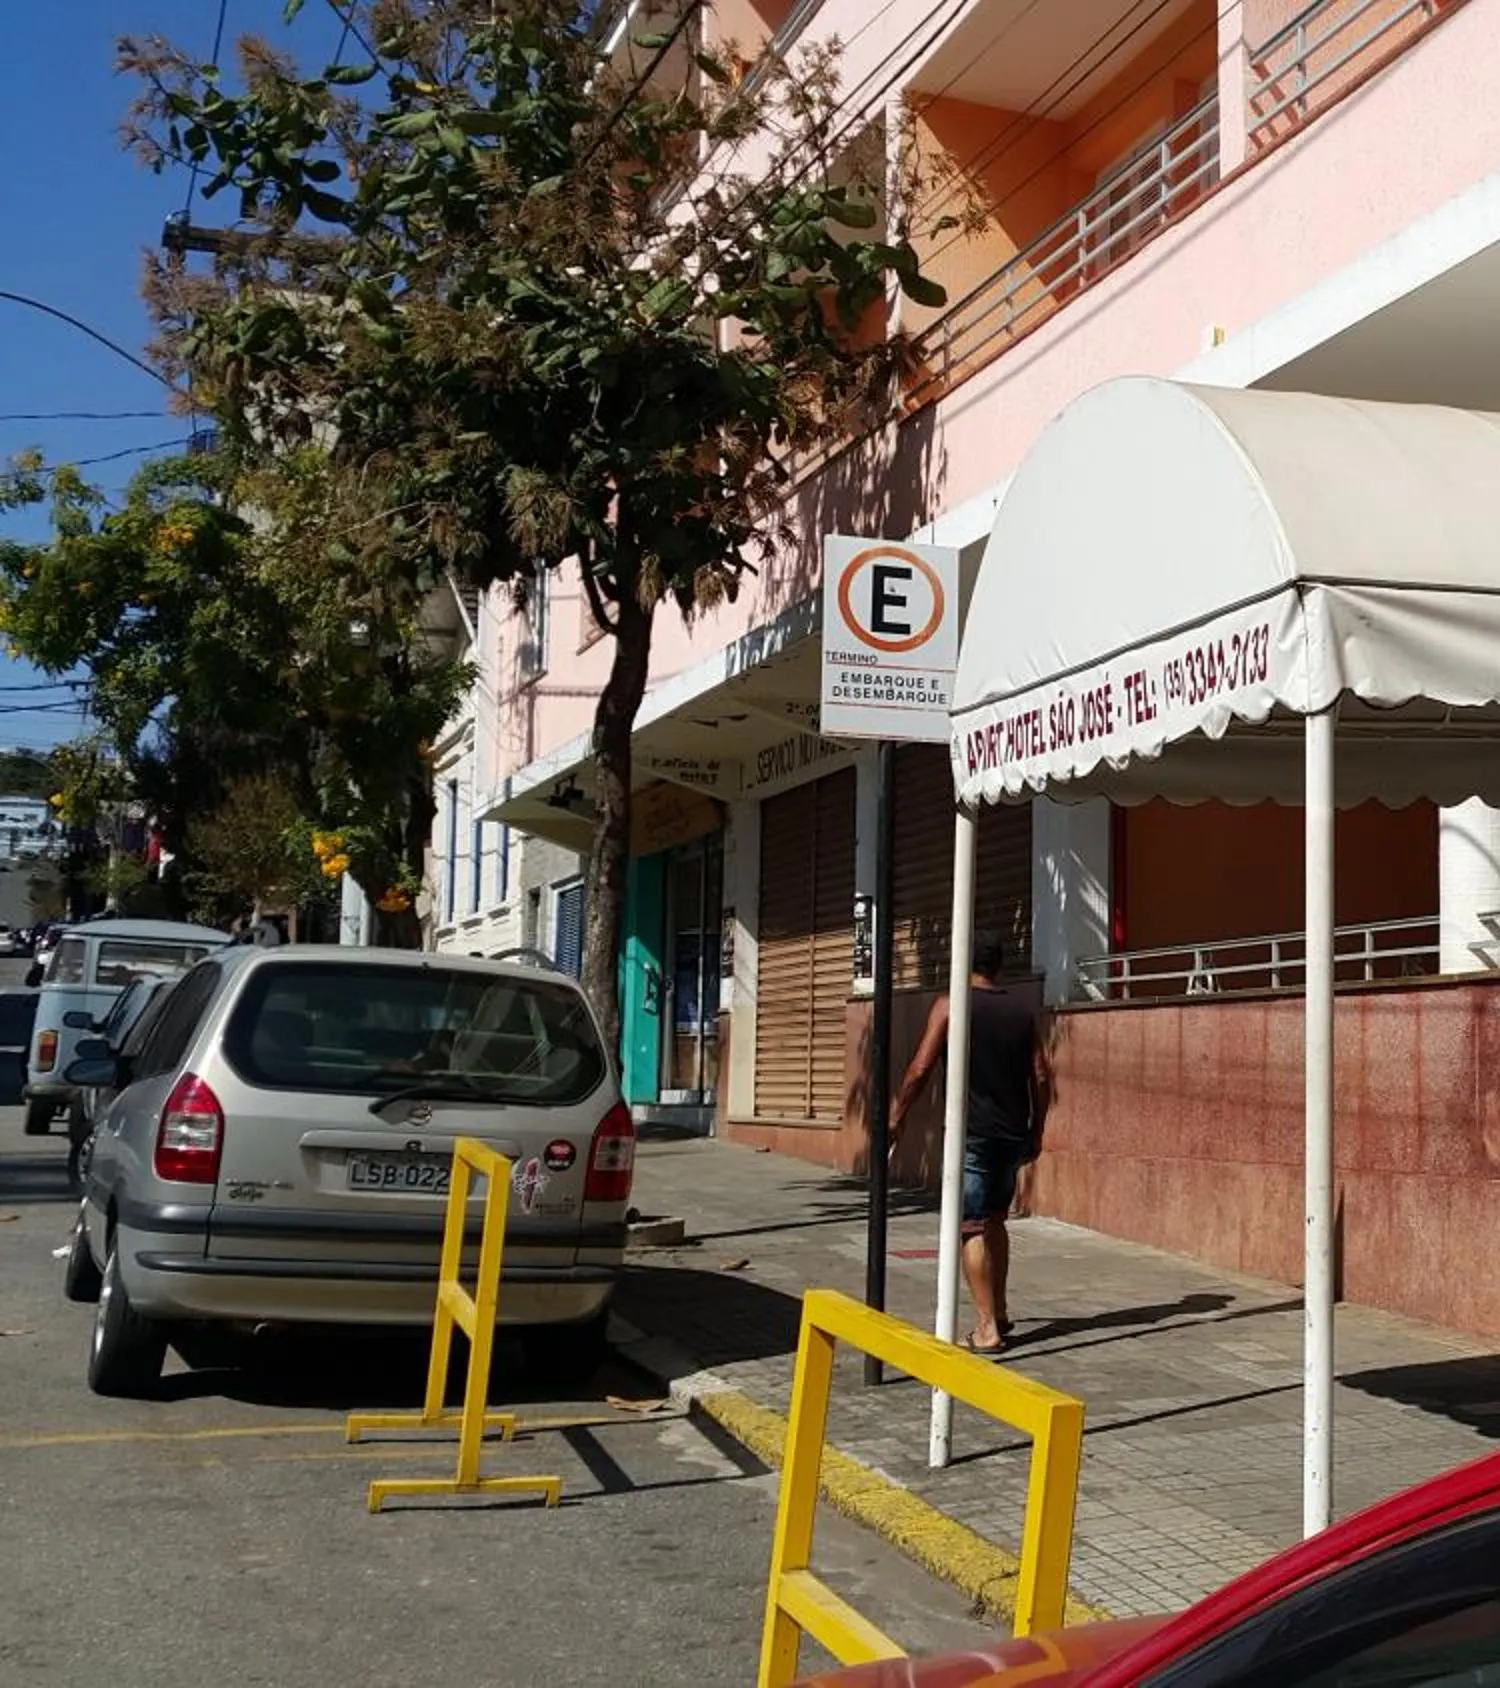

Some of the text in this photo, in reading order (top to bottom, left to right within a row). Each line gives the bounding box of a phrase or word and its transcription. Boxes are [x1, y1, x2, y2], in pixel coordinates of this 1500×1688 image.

[870, 564, 913, 635] E
[831, 685, 949, 704] DESEMBARQUE
[840, 671, 941, 690] EMBARQUE E
[967, 721, 1004, 778] APART
[1004, 707, 1047, 763] HOTEL
[1049, 690, 1076, 752] SÃO
[1078, 671, 1114, 744] JOSÉ
[1123, 669, 1157, 727] TEL:
